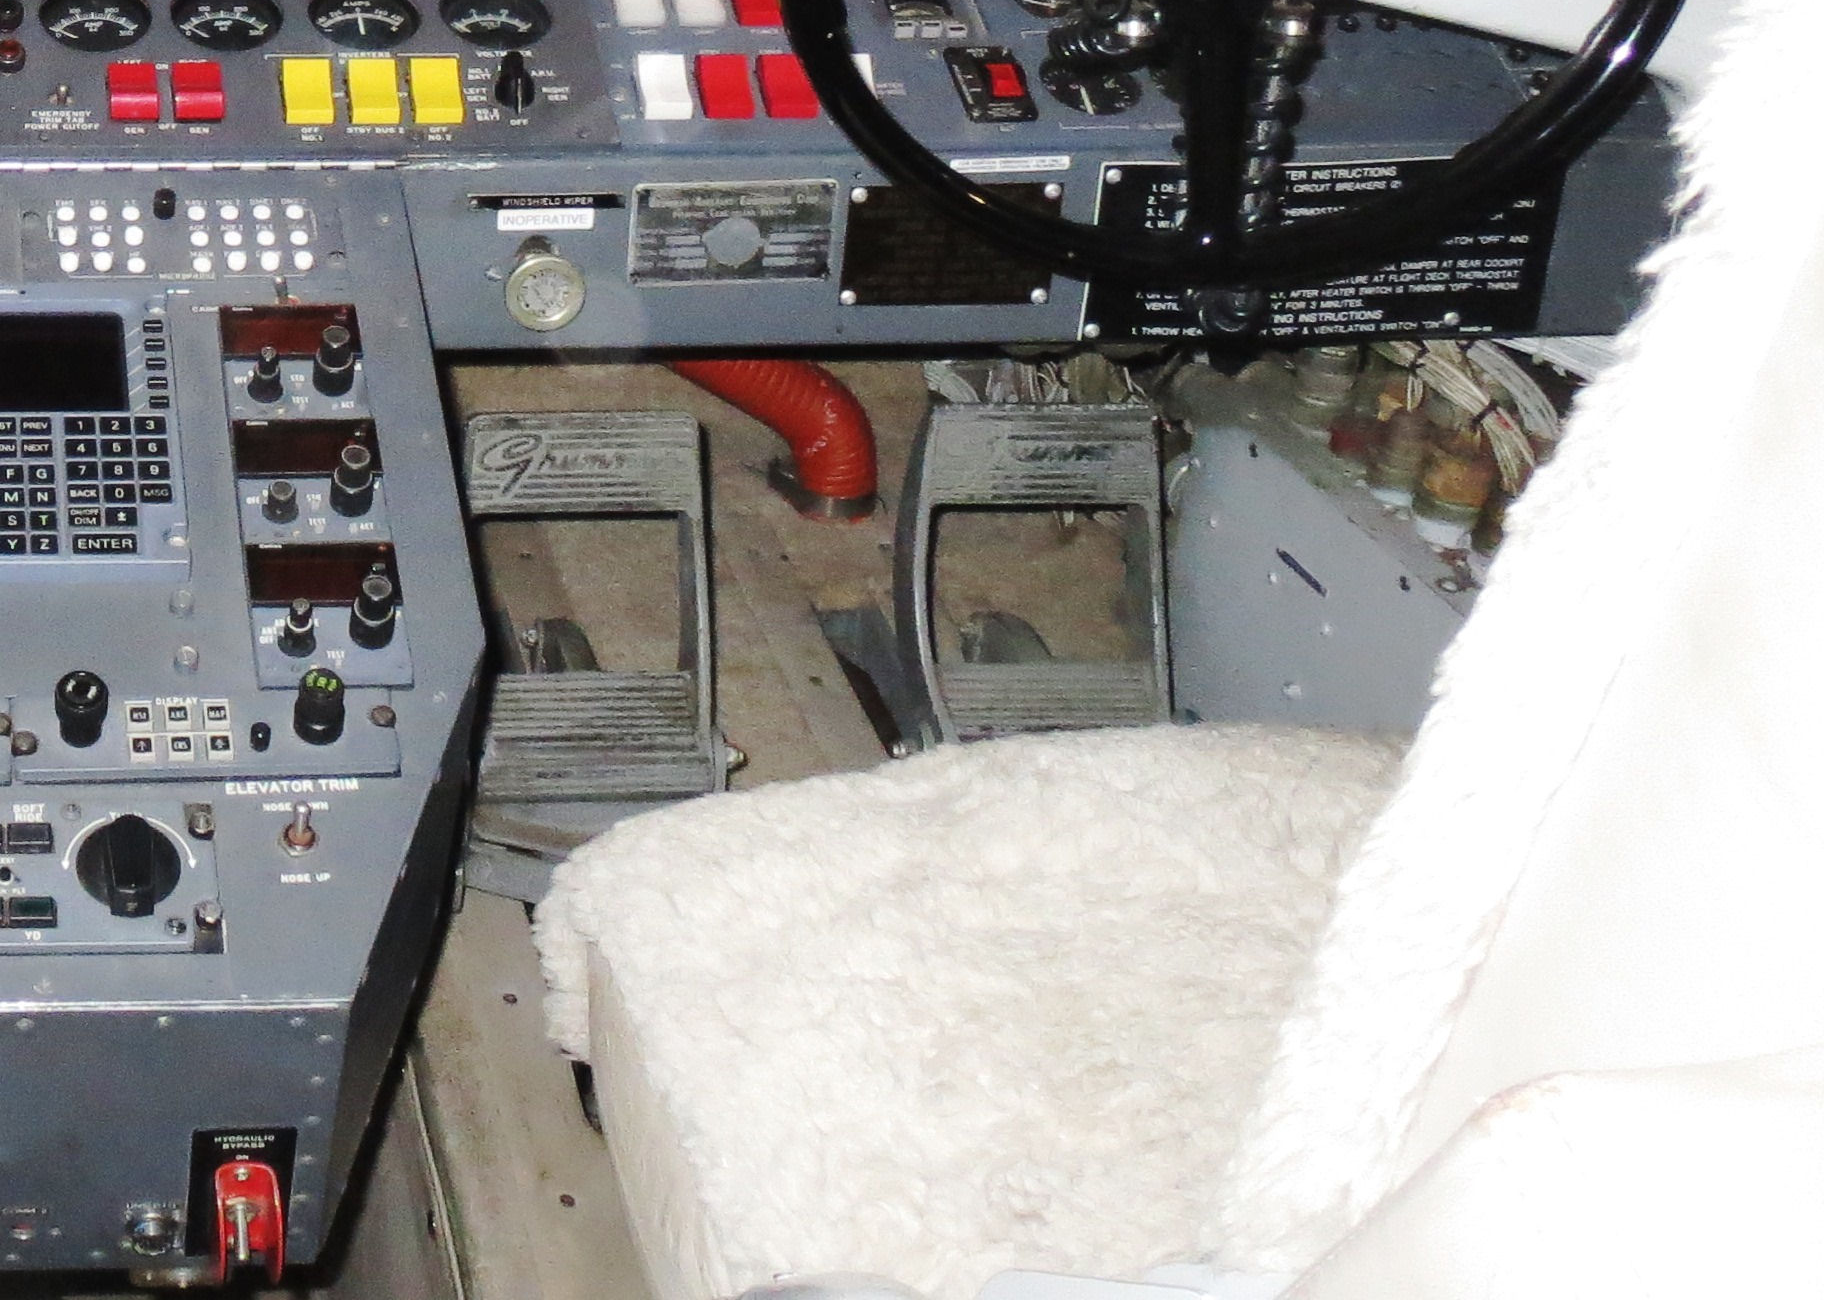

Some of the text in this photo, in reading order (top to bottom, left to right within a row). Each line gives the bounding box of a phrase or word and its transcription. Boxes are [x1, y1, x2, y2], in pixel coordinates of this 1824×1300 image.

[32, 111, 90, 120] EMERGENCY
[1312, 166, 1396, 179] INSTRUCTIONS
[1294, 181, 1386, 192] CIRCUIT BREAKERS
[503, 214, 585, 225] INOPERATIVE
[1299, 310, 1383, 322] INSTRUCTIONS
[78, 421, 154, 430] 1 2 3
[77, 443, 157, 452] 4 5 6
[7, 469, 14, 478] F
[37, 469, 47, 479] G
[79, 465, 158, 474] 7 8 9
[5, 492, 18, 501] M
[38, 492, 48, 501] N
[115, 488, 124, 498] 0
[8, 515, 17, 525] S
[39, 515, 48, 525] T
[8, 539, 17, 549] Y
[40, 539, 49, 549] Z
[78, 539, 132, 549] ENTER
[155, 697, 199, 706] DISPLAY
[225, 779, 358, 795] ELEVATOR TRIM
[12, 804, 45, 814] SOFT
[14, 814, 43, 823] RIDE
[281, 874, 310, 882] NOSE
[25, 931, 41, 940] YD
[223, 1139, 265, 1149] BYPASS
